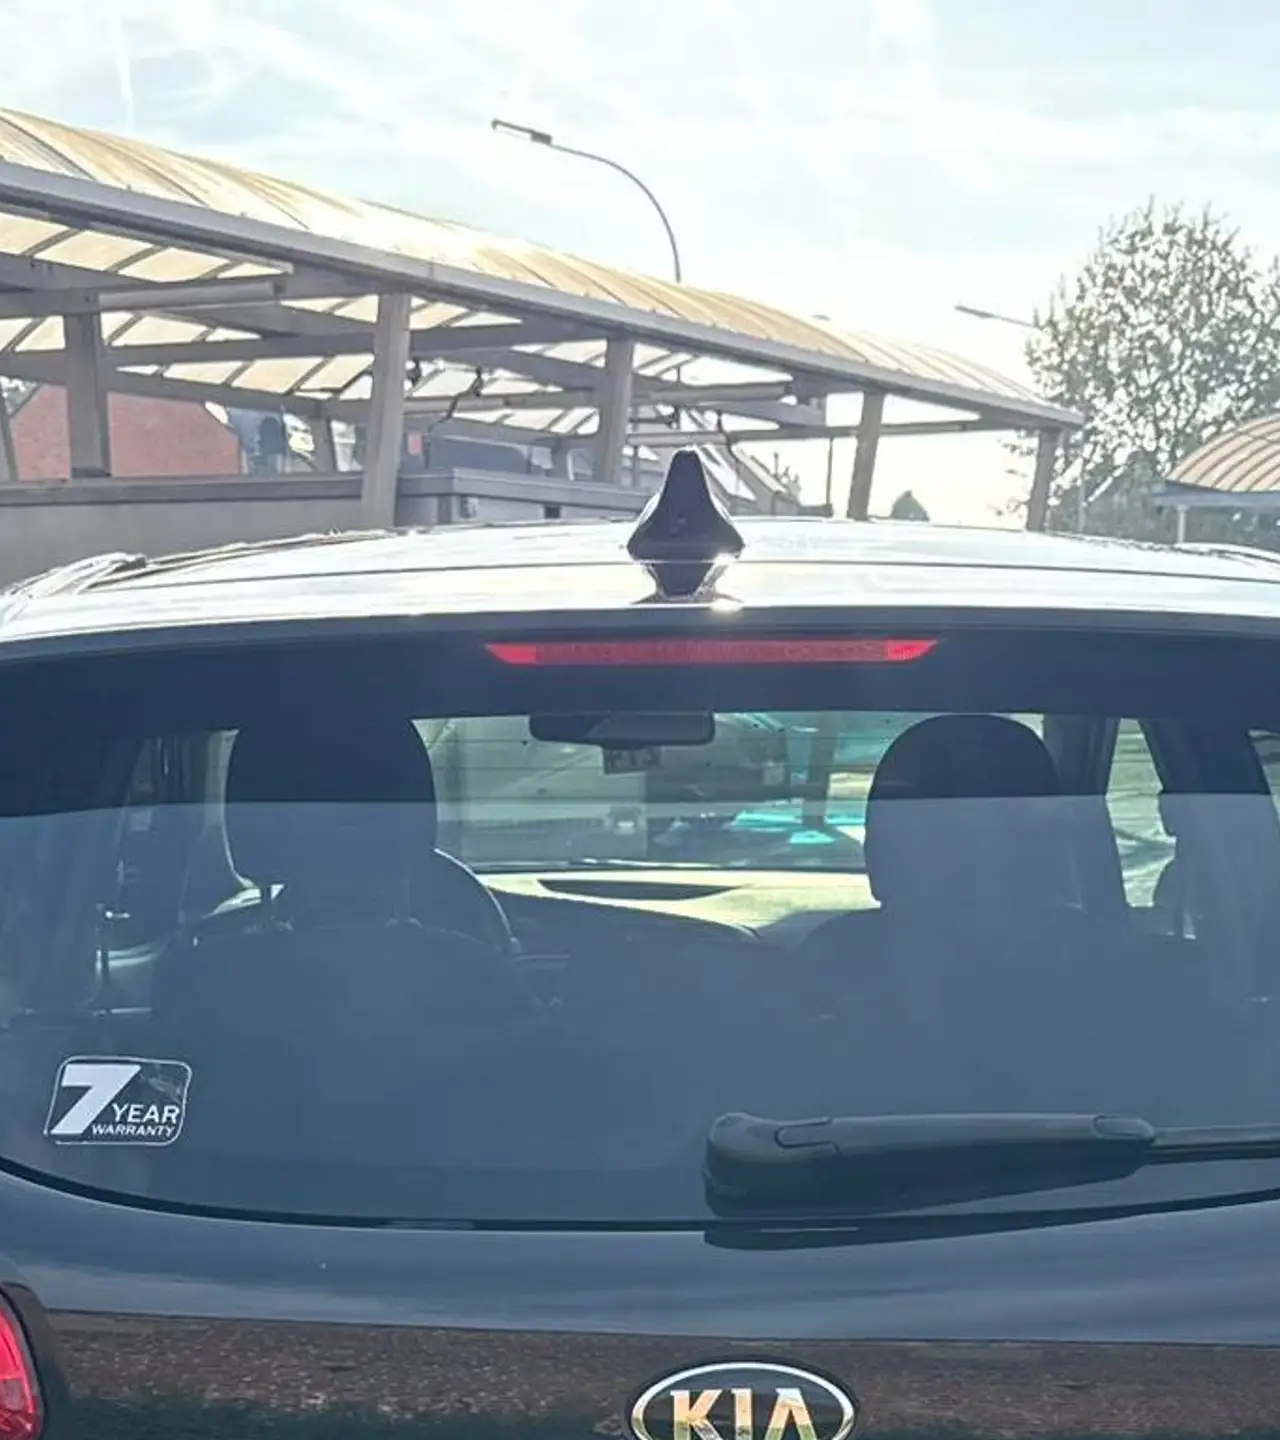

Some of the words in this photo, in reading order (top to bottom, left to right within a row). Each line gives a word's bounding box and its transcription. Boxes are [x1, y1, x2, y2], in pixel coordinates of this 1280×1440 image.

[50, 1063, 142, 1134] 7
[111, 1103, 180, 1124] YEAR
[92, 1124, 175, 1137] WARRANTY
